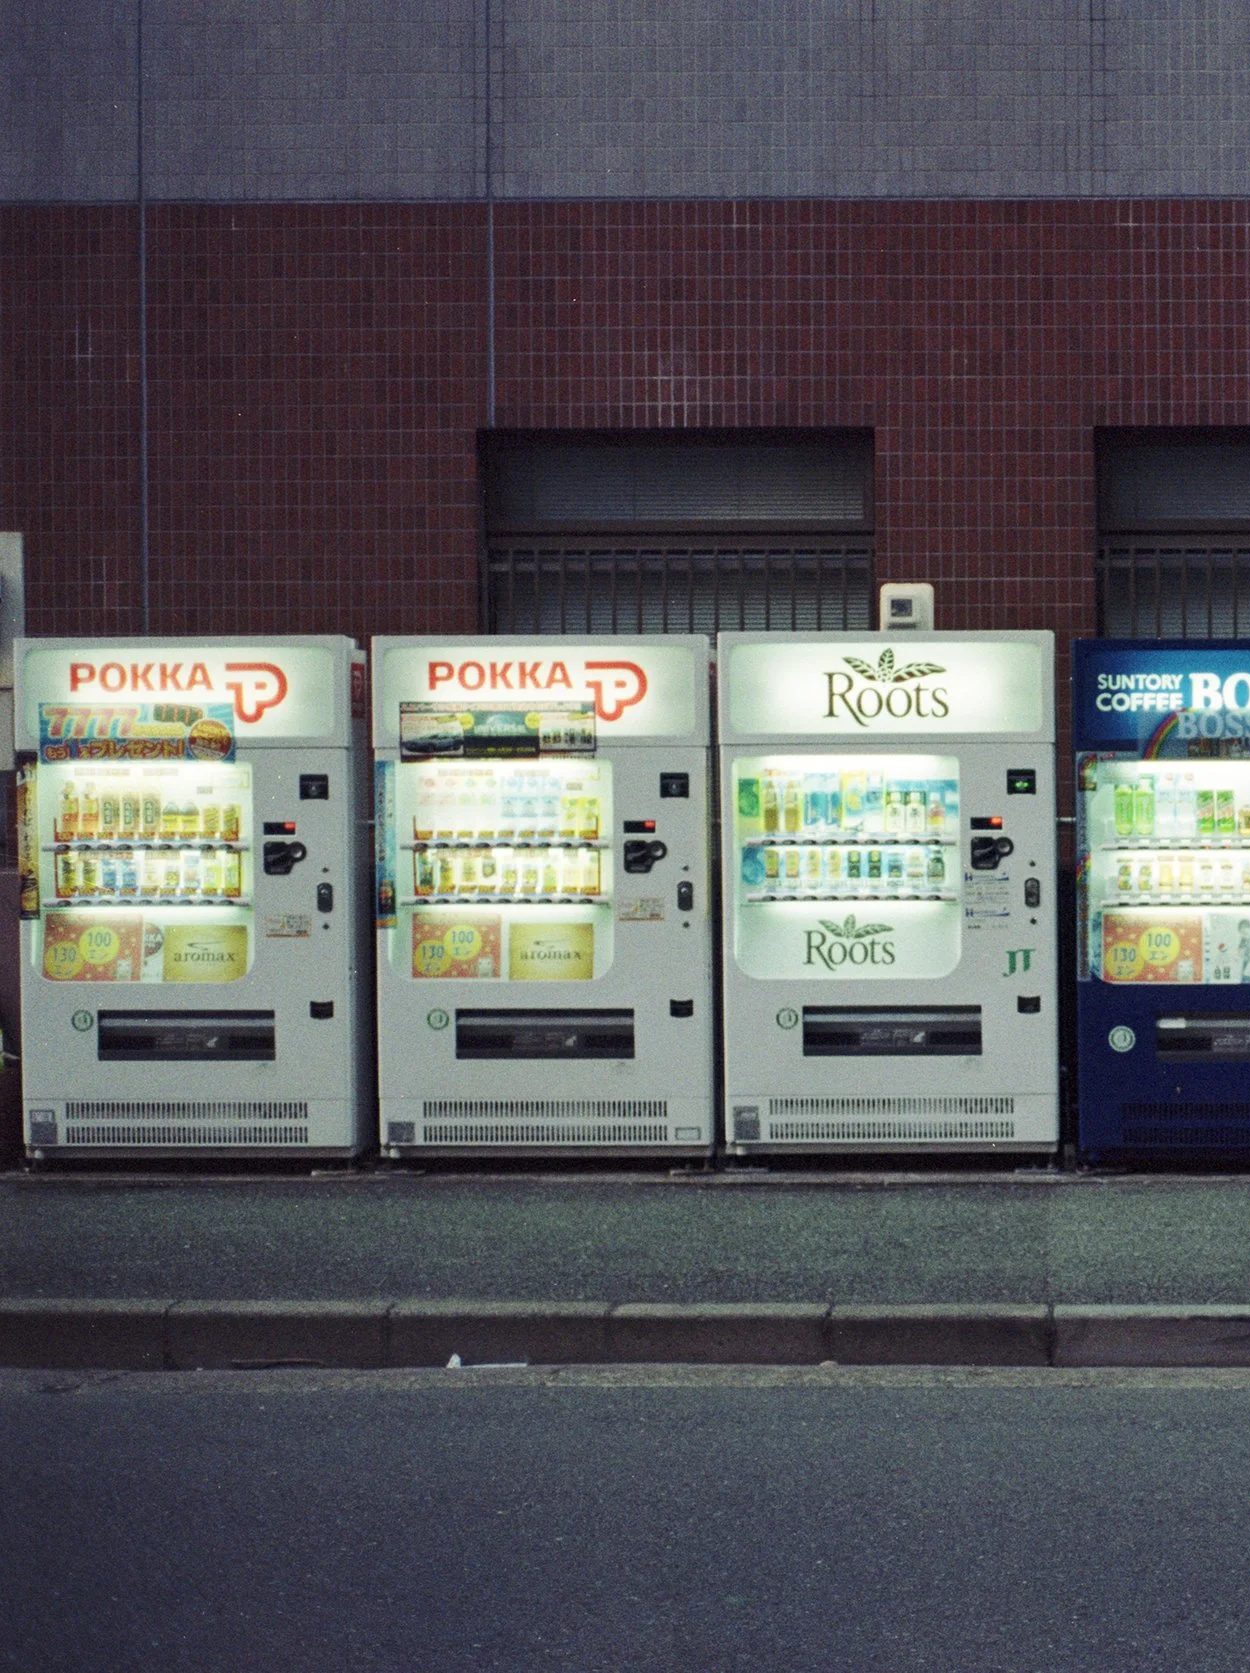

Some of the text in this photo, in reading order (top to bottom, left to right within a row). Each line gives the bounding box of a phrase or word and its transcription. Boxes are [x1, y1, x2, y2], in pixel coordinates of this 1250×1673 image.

[70, 663, 214, 692] POKKA
[428, 661, 572, 690] POKKA
[1097, 674, 1183, 690] SUNTORY
[822, 672, 949, 727] Roots
[1096, 692, 1184, 712] COFFEE
[87, 932, 112, 947] 100
[451, 930, 475, 944] 100
[1146, 933, 1172, 948] 100
[52, 948, 77, 962] 130
[173, 949, 236, 963] aromax
[420, 945, 445, 961] 130
[519, 948, 583, 961] aromax
[803, 930, 896, 970] Roots
[1112, 947, 1138, 963] 130
[1147, 950, 1169, 962] エン
[1002, 948, 1037, 978] JT
